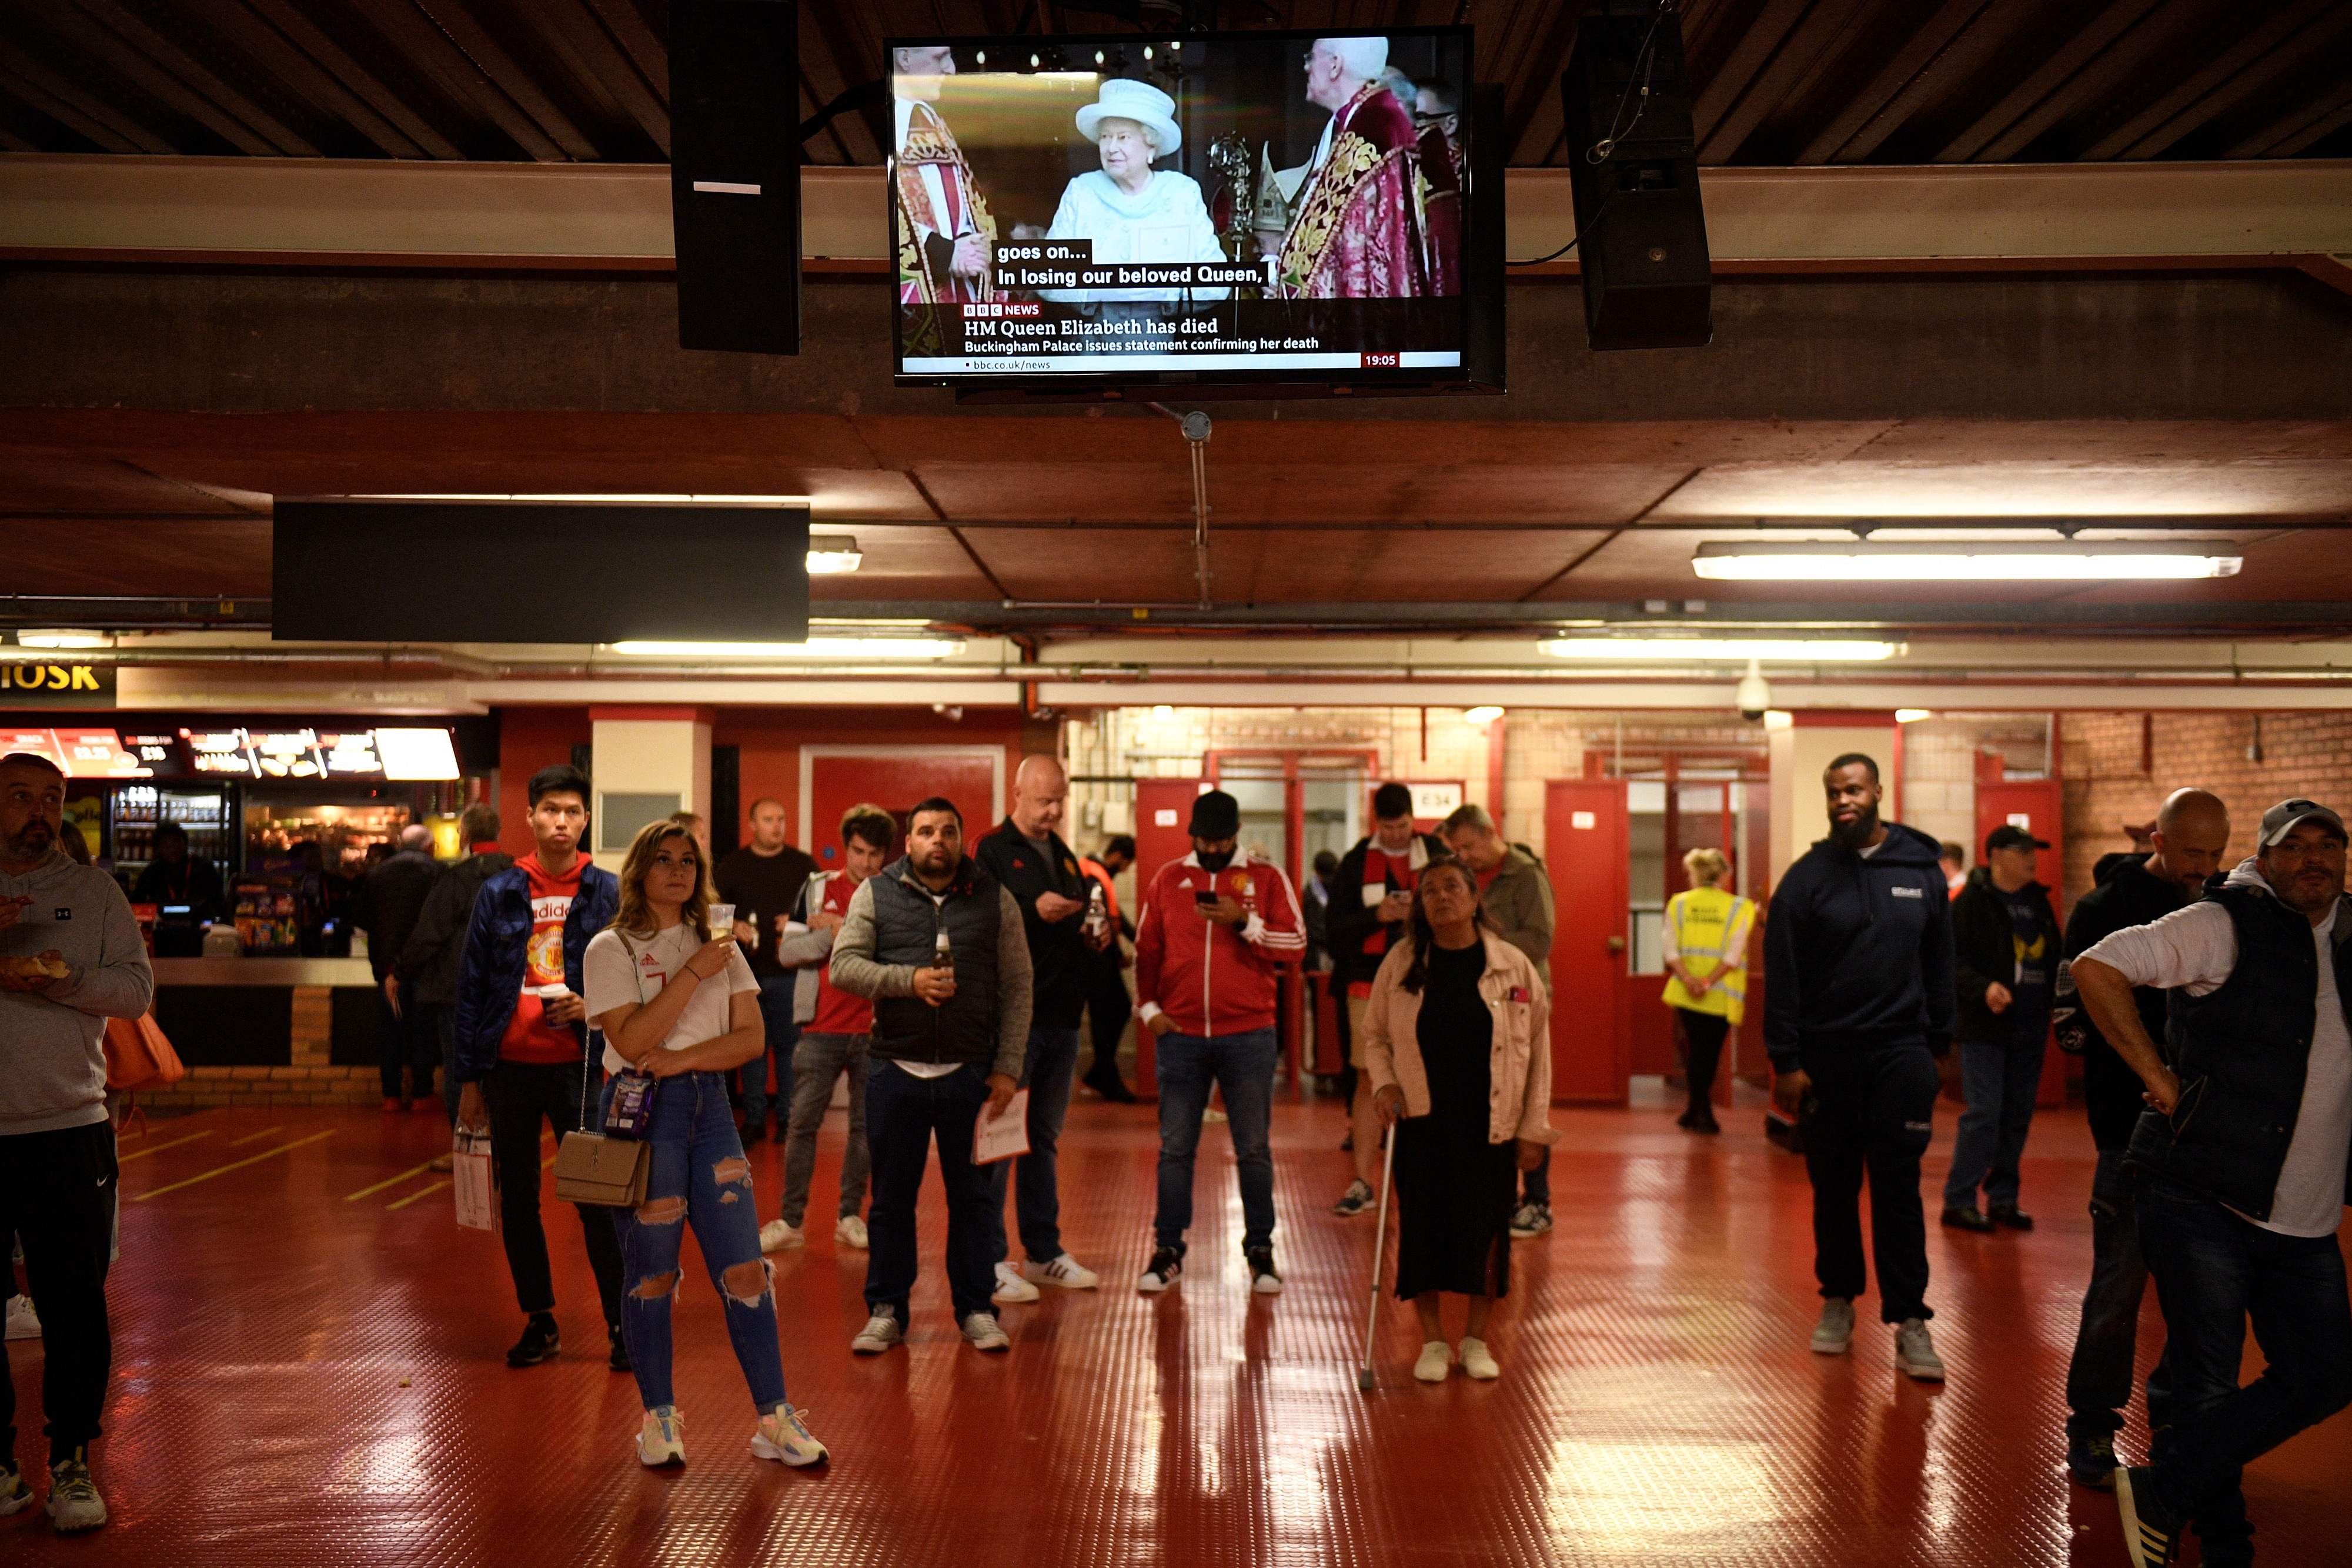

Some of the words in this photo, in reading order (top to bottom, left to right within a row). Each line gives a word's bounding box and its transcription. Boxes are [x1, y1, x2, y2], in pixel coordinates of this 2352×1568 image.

[997, 247, 1041, 263] goes
[1046, 246, 1086, 259] on...
[998, 269, 1015, 285] In
[1021, 268, 1076, 287] losing
[1082, 271, 1113, 284] our
[1119, 266, 1191, 283] beloved
[1197, 266, 1262, 283] Queen,
[964, 305, 1002, 316] BBC
[1005, 305, 1039, 315] NEWS
[964, 321, 996, 336] HM
[1001, 321, 1056, 336] Queen
[1060, 319, 1142, 335] Elizabeth
[1145, 318, 1177, 335] has
[1180, 317, 1218, 334] died
[965, 340, 1040, 355] Buckingham
[1043, 339, 1083, 352] Palace
[1085, 339, 1122, 352] issues
[1124, 339, 1188, 351] statement
[1191, 337, 1257, 352] confirming
[1260, 337, 1281, 349] her
[1283, 336, 1319, 349] death
[973, 360, 1051, 370] bbc.co.uk/news
[1365, 355, 1396, 366] 19:05
